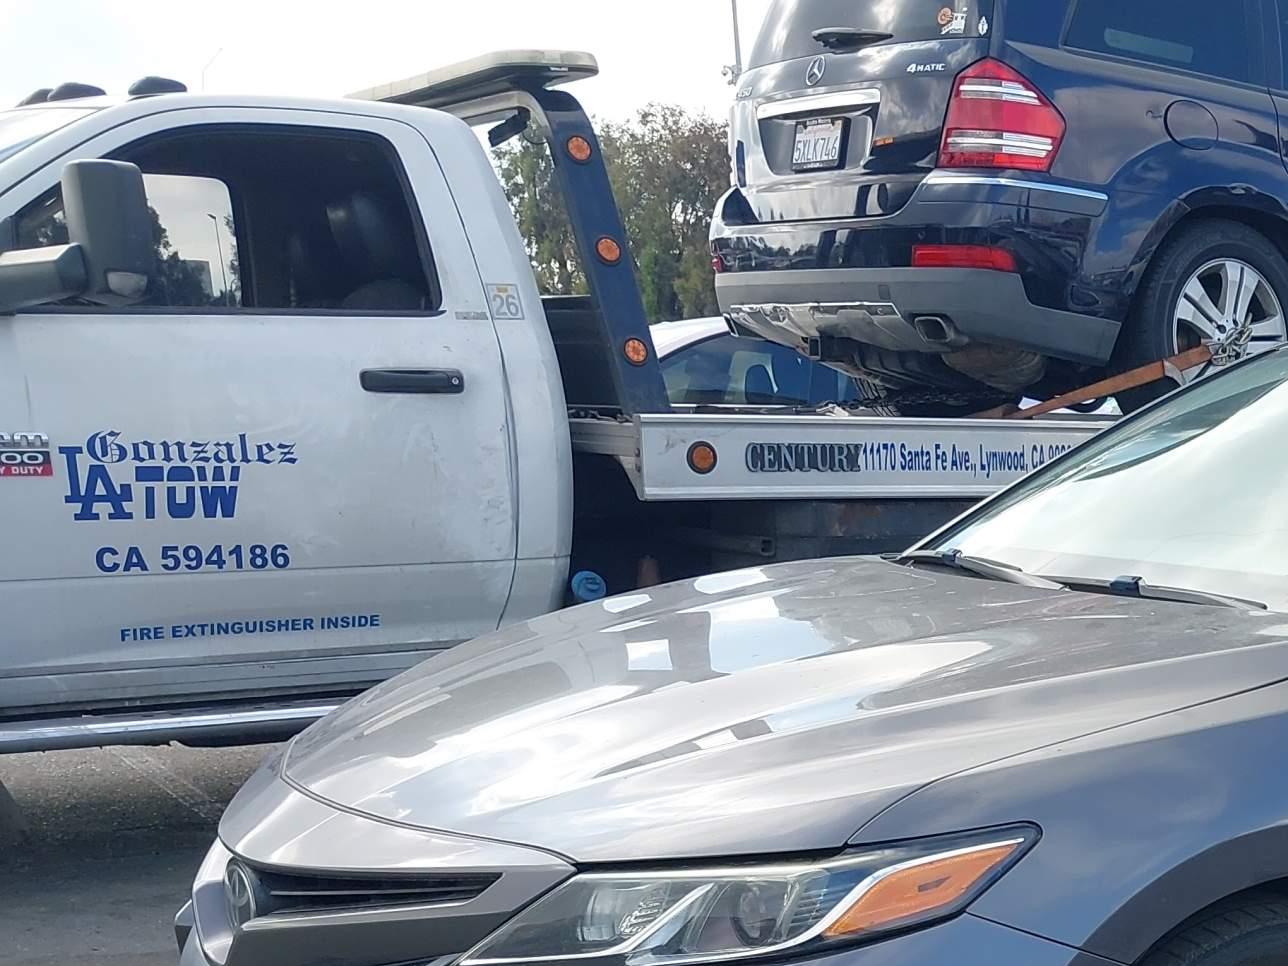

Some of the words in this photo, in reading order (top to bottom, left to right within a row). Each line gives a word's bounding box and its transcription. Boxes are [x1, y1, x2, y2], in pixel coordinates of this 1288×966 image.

[492, 294, 519, 316] 26
[86, 430, 298, 464] Gonzalez
[745, 442, 863, 473] CENTURY
[863, 442, 897, 471] 11170
[900, 442, 931, 471] Santa
[935, 443, 948, 471] Fe
[980, 443, 1029, 479] Lynwood,
[1031, 444, 1045, 470] CA
[11, 466, 44, 475] DUTY
[58, 446, 133, 520] LA
[135, 465, 240, 519] TOW
[96, 546, 149, 573] CA
[161, 544, 290, 571] 594186
[120, 627, 165, 641] FIRE
[171, 618, 314, 639] EXTINGUISHER
[320, 615, 380, 629] INSIDE
